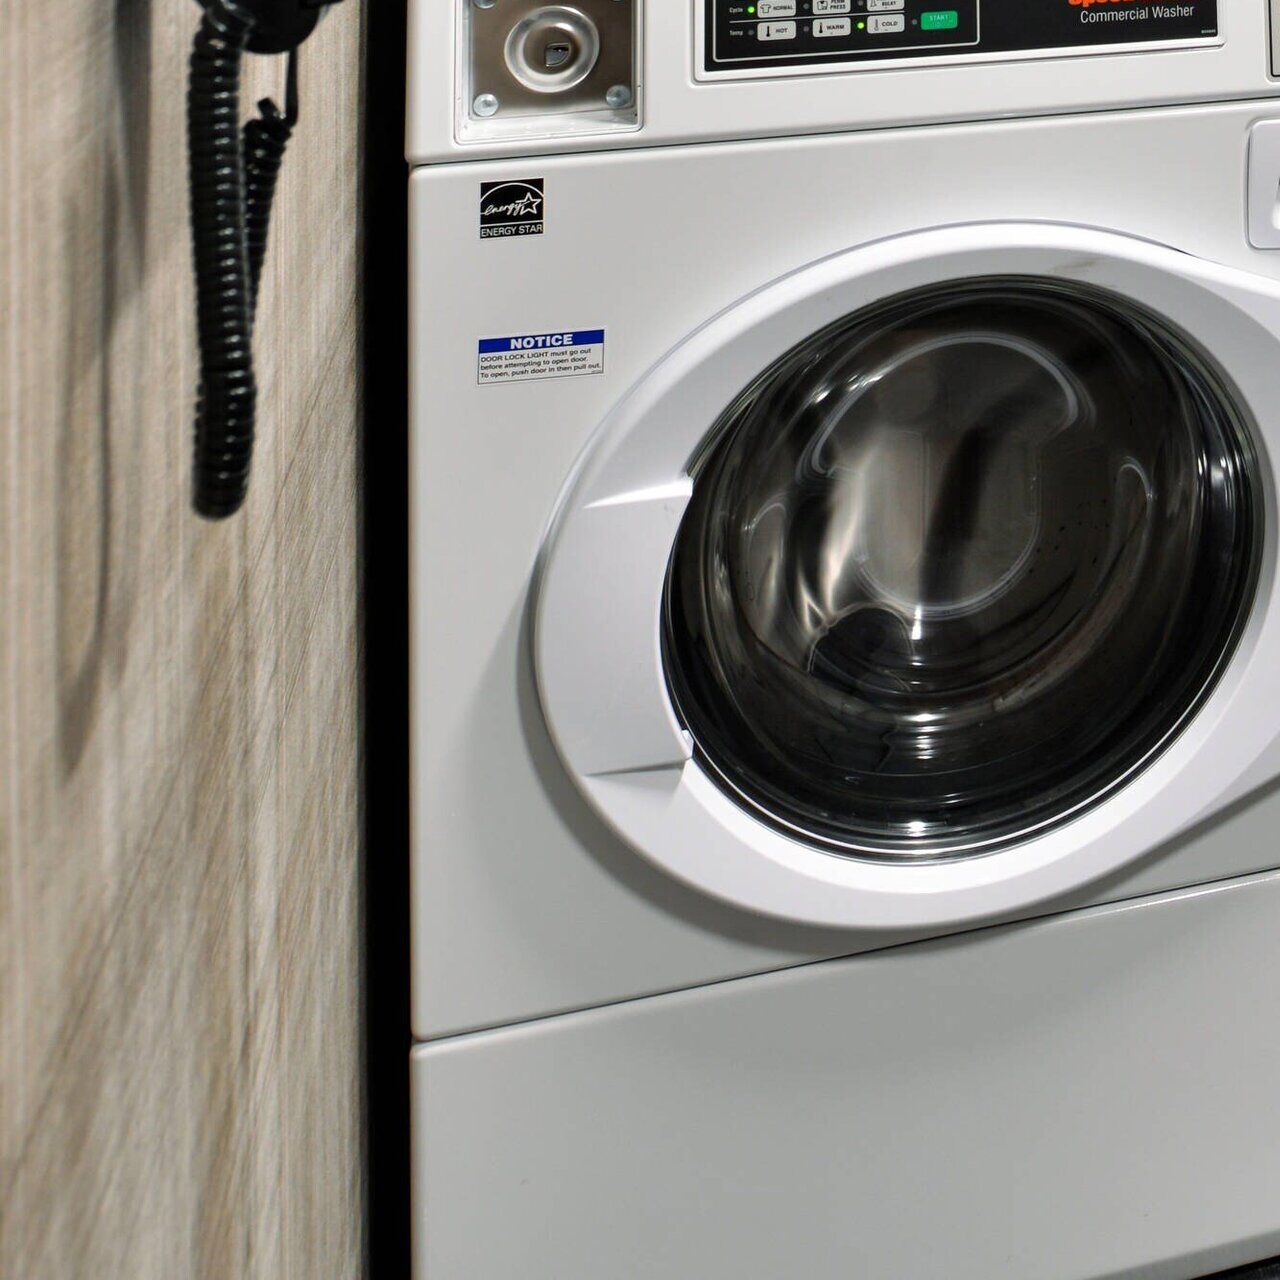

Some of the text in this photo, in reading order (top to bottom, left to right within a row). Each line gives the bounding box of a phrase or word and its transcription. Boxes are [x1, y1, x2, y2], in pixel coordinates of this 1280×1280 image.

[729, 6, 744, 14] Cycle
[1080, 5, 1195, 23] Commercial Washer
[730, 29, 744, 37] Temp
[482, 224, 543, 237] ENERGY STAR
[510, 334, 574, 349] NOTICE
[505, 353, 527, 361] LOCK
[504, 360, 541, 369] attempting
[490, 371, 510, 379] open,
[512, 368, 529, 377] push
[574, 363, 589, 371] pull
